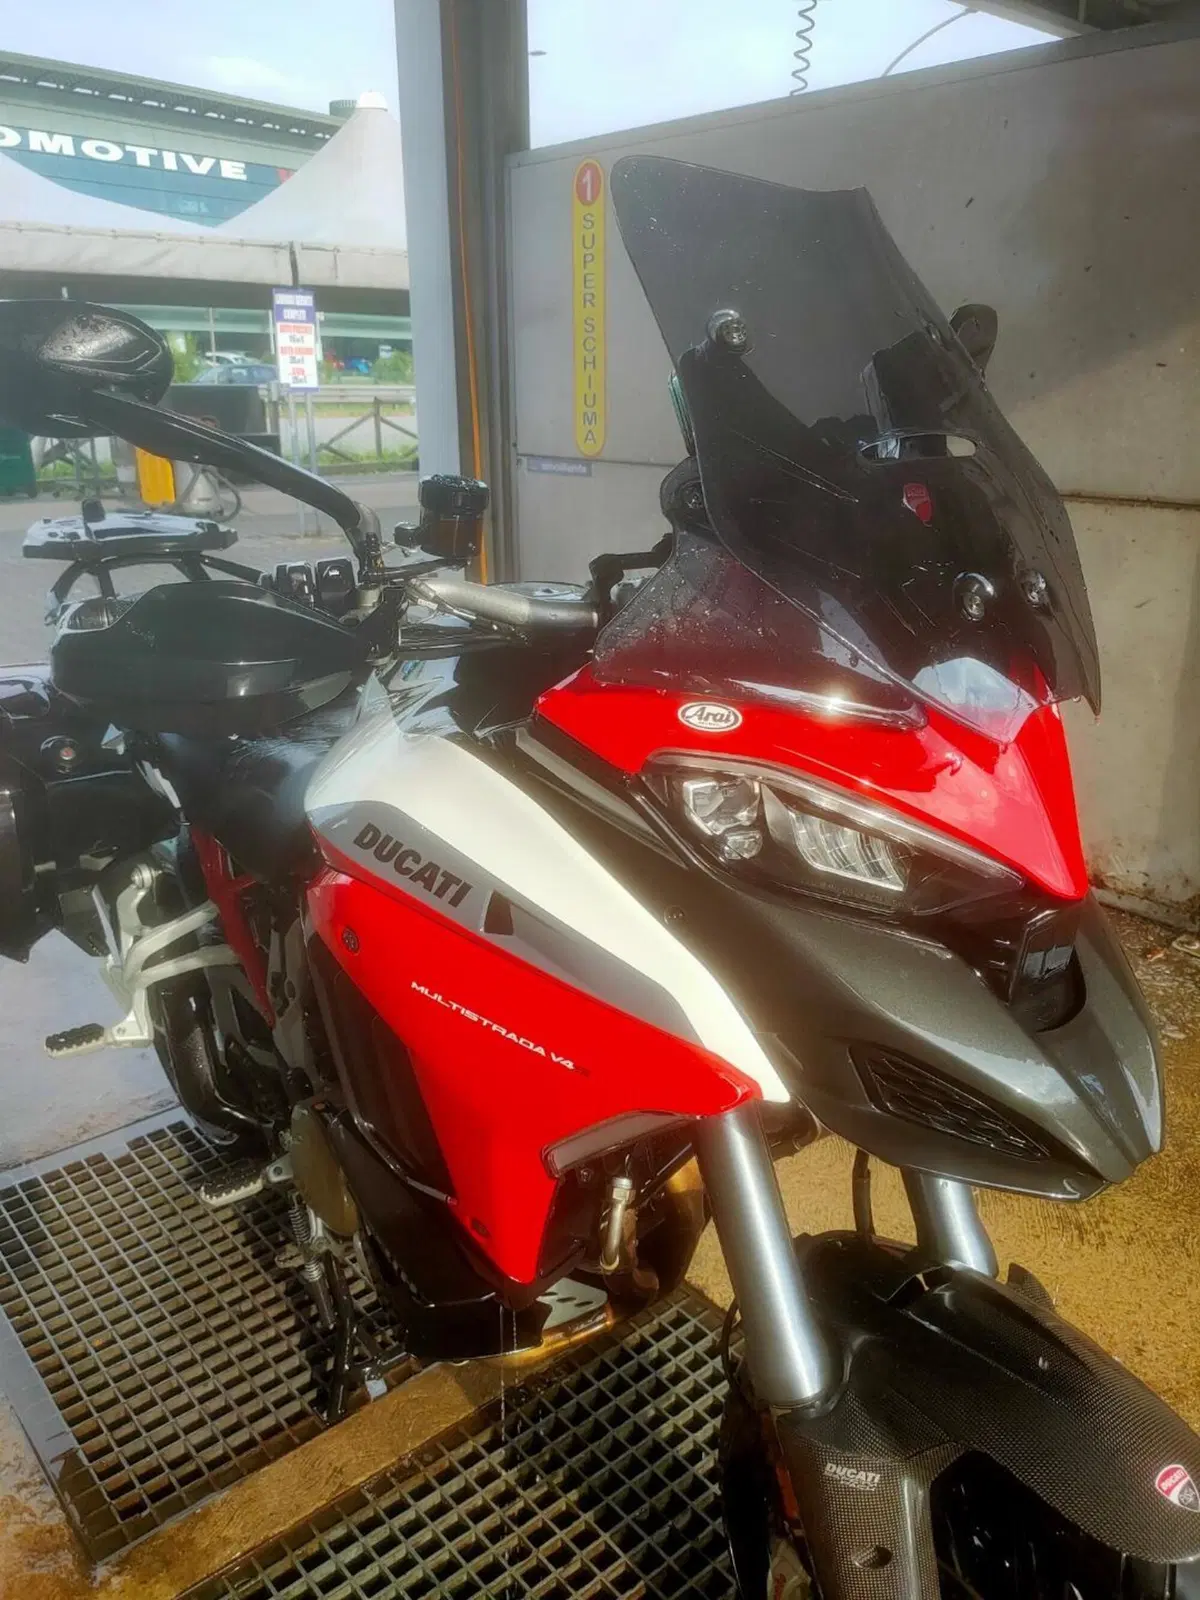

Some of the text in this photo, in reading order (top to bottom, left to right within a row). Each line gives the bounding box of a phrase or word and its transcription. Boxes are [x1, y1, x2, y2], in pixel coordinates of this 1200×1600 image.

[581, 168, 593, 201] 1
[581, 212, 598, 445] SUPER SCHIUMA
[686, 706, 732, 724] Arai
[353, 822, 475, 909] DUCATI
[410, 980, 576, 1070] MULTISTRADA V4
[824, 1461, 881, 1483] DUCATI
